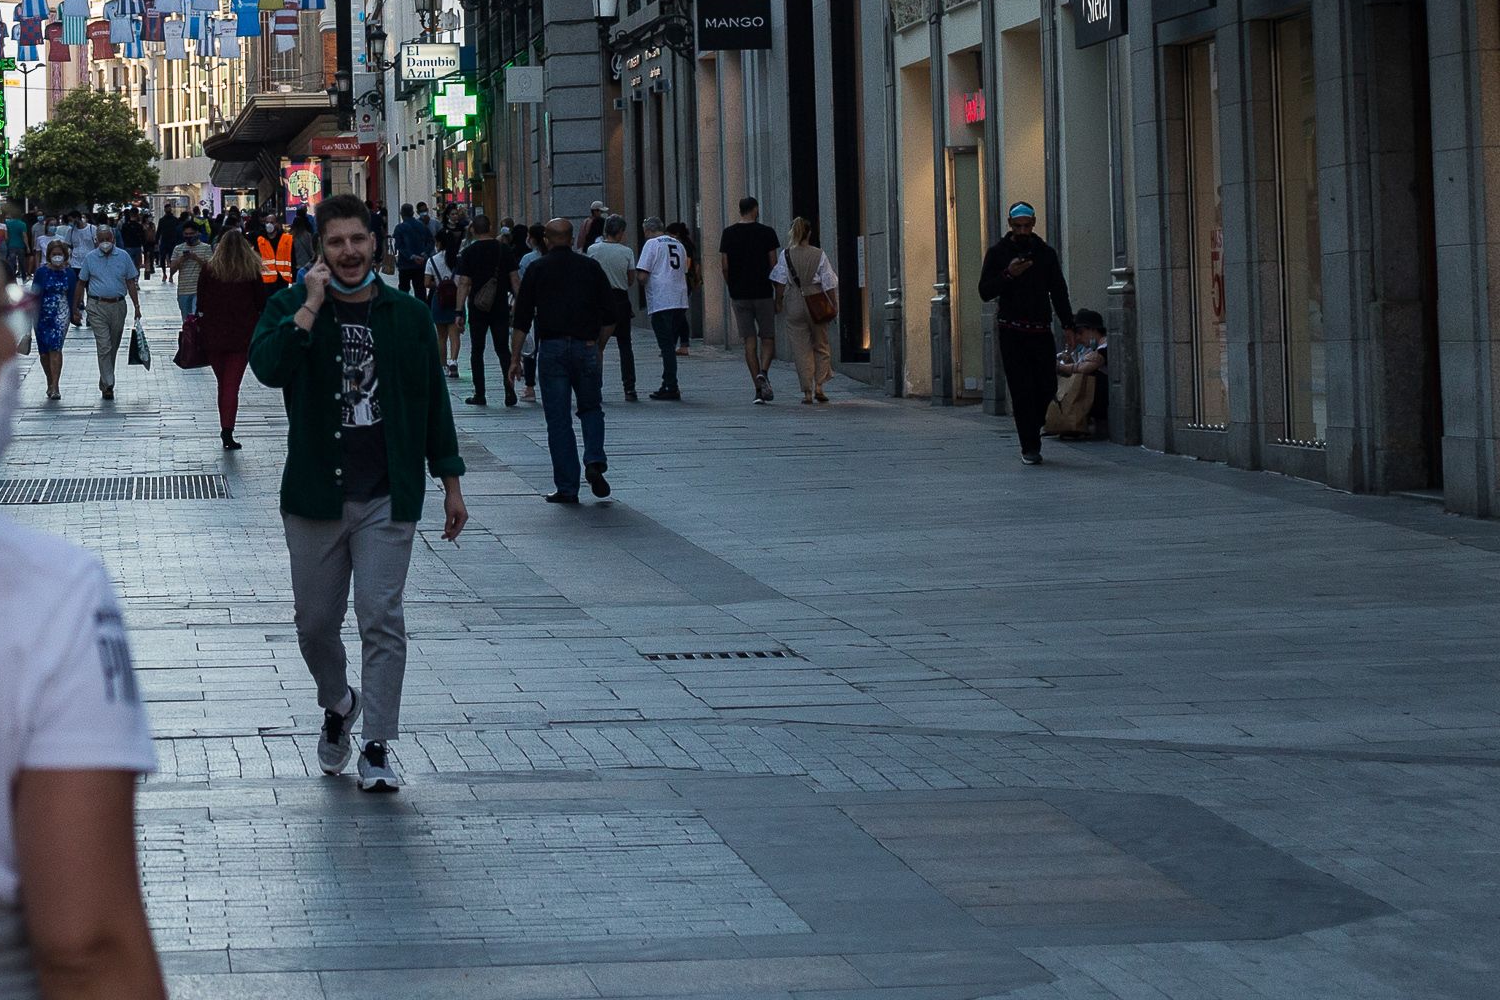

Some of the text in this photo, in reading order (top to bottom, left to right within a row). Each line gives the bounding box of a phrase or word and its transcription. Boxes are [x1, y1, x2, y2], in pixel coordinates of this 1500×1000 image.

[705, 16, 764, 28] MANGO
[406, 45, 420, 56] El
[406, 57, 456, 67] Danubio
[406, 68, 436, 79] Azul
[667, 243, 681, 270] 5
